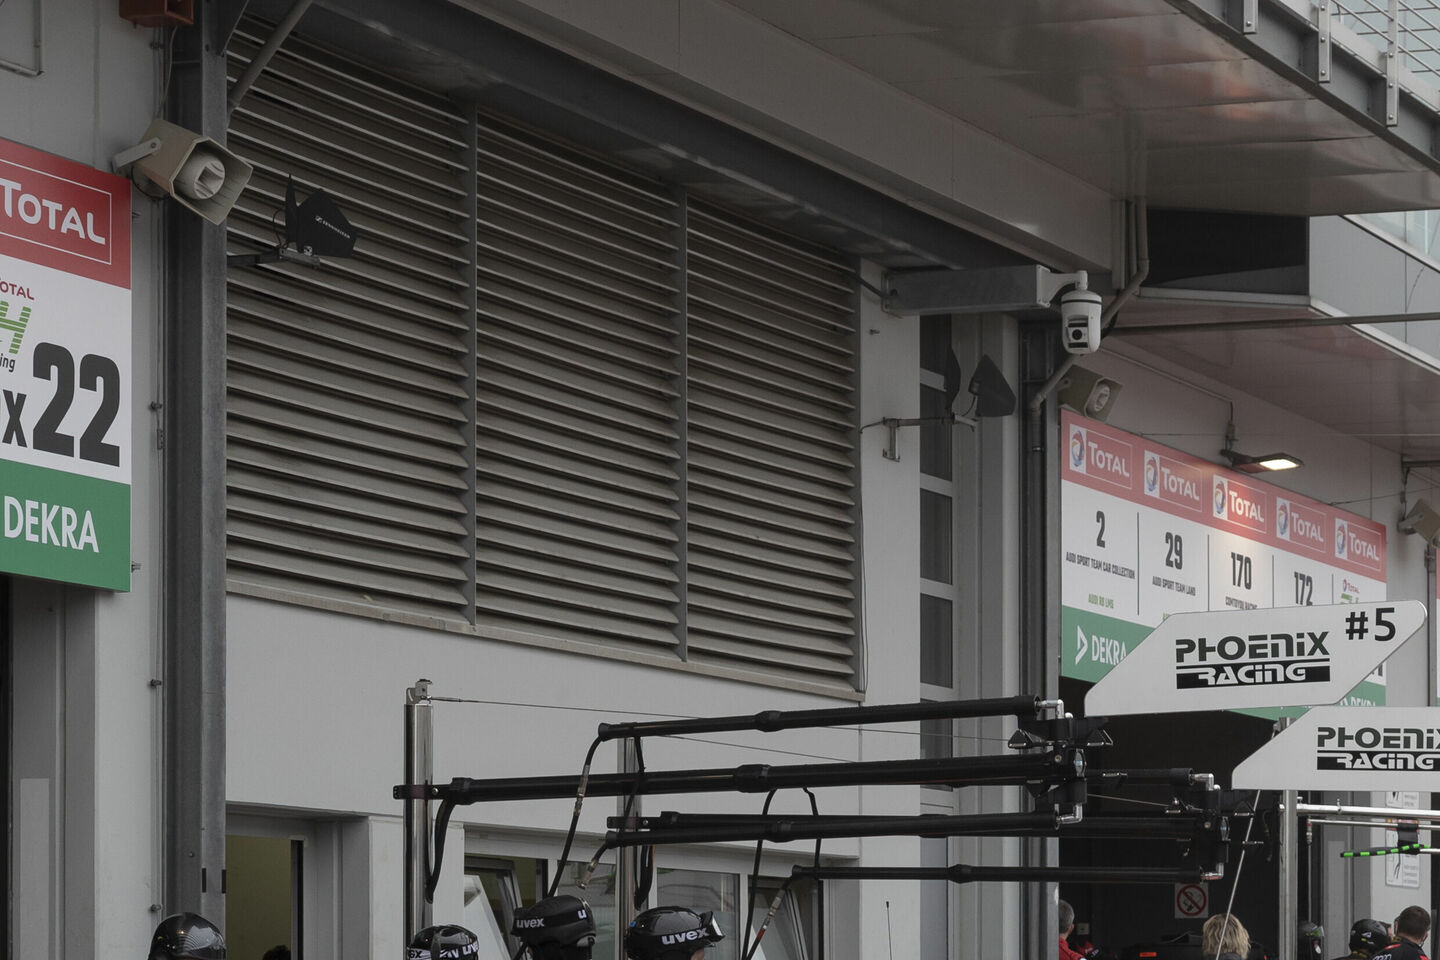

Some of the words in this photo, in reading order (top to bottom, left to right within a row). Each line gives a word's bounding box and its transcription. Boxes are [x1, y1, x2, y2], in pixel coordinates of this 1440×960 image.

[0, 181, 106, 246] TOTAL
[1088, 441, 1130, 478] TOTAL
[1161, 467, 1200, 502] TOTAL
[1229, 491, 1264, 523] TOTAL
[3, 495, 99, 553] DEKRA
[1096, 510, 1106, 549] 2
[1290, 512, 1324, 542] TOTAL
[1165, 532, 1183, 570] 29
[1349, 532, 1380, 561] TOTAL
[1091, 558, 1102, 571] TEAM
[1231, 552, 1252, 590] 170
[1294, 571, 1313, 606] 172
[1345, 607, 1396, 642] #5
[1091, 633, 1127, 665] DEKRA
[1176, 631, 1330, 663] PHOENIX
[1198, 662, 1307, 687] RACING
[1337, 753, 1434, 770] RACING
[516, 917, 545, 929] uvex
[662, 926, 710, 946] uvex
